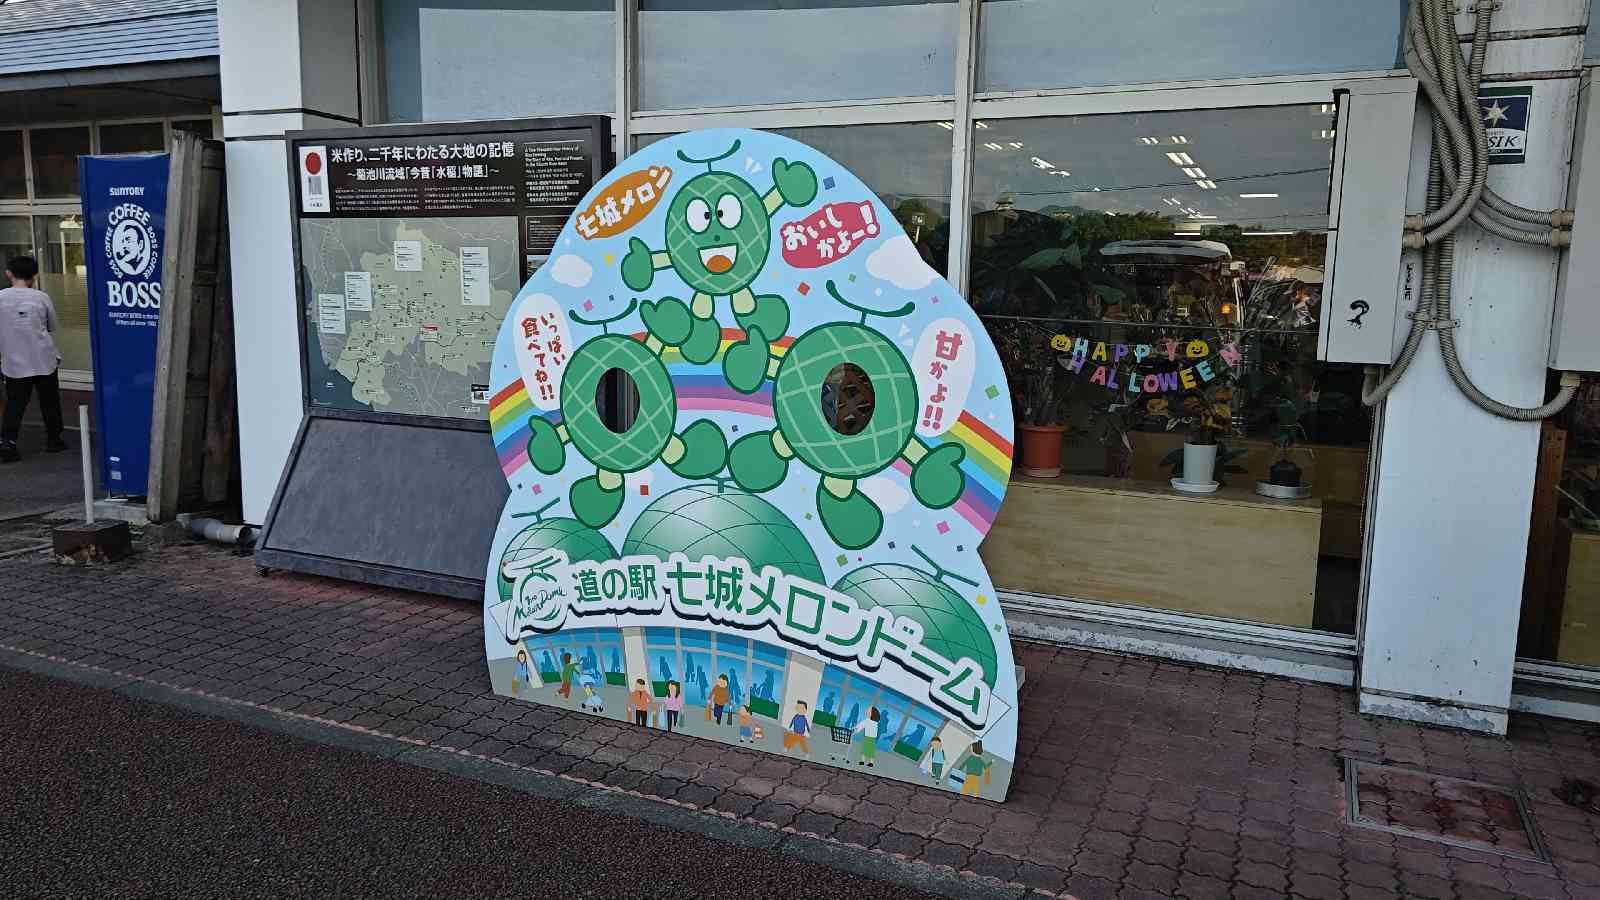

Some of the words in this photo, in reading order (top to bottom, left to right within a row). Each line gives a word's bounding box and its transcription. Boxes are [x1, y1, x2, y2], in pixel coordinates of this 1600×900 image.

[331, 141, 514, 163] 米作り、二千年にわたる大地の記憶
[109, 186, 145, 196] SUNTORY
[577, 168, 671, 237] 七城メロン
[108, 203, 151, 225] COFFEE
[782, 206, 843, 251] おいし
[107, 281, 160, 309] BOSS
[540, 312, 566, 366] いっぱい
[1072, 336, 1181, 364] HAPPY
[572, 563, 658, 602] 道の駅
[666, 560, 981, 715] 七城メロンドーム
